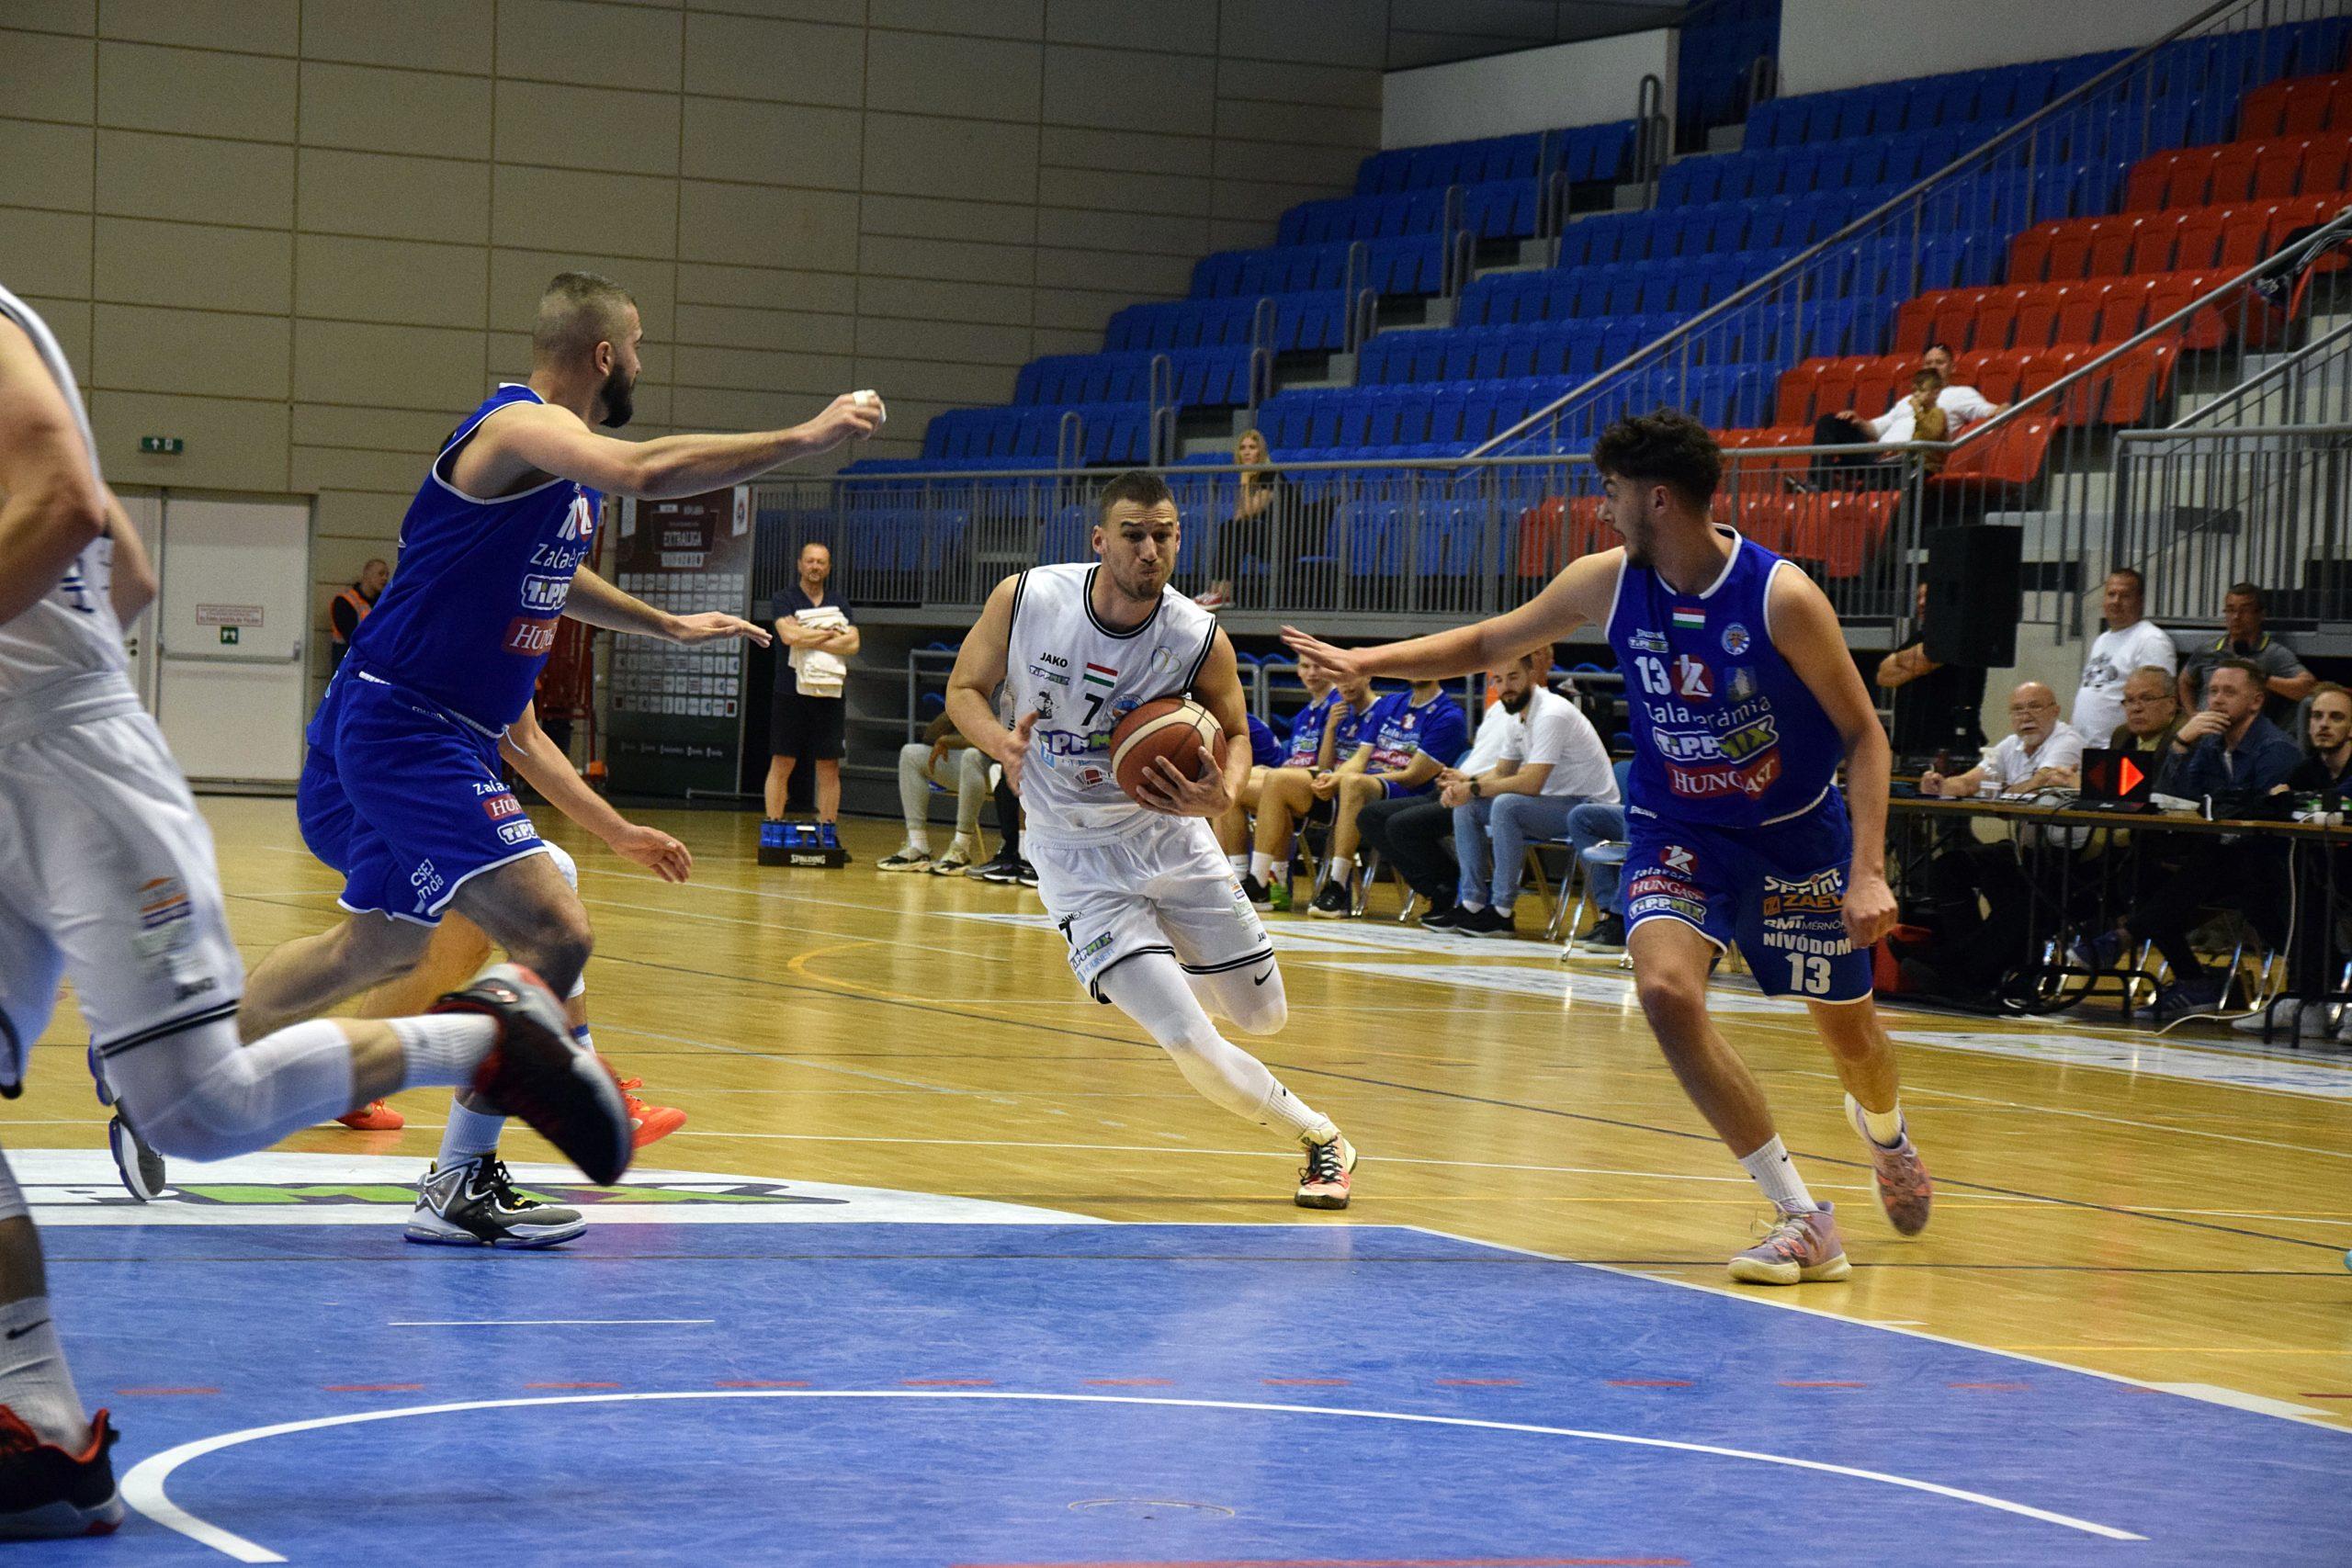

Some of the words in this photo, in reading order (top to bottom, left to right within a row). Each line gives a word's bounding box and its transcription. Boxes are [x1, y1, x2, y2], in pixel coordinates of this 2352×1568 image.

[1039, 651, 1069, 669] JAKO
[1634, 656, 1672, 696] 13
[1080, 692, 1104, 726] 7
[1763, 931, 1852, 956] NÍVÓDOM
[1784, 952, 1832, 995] 13
